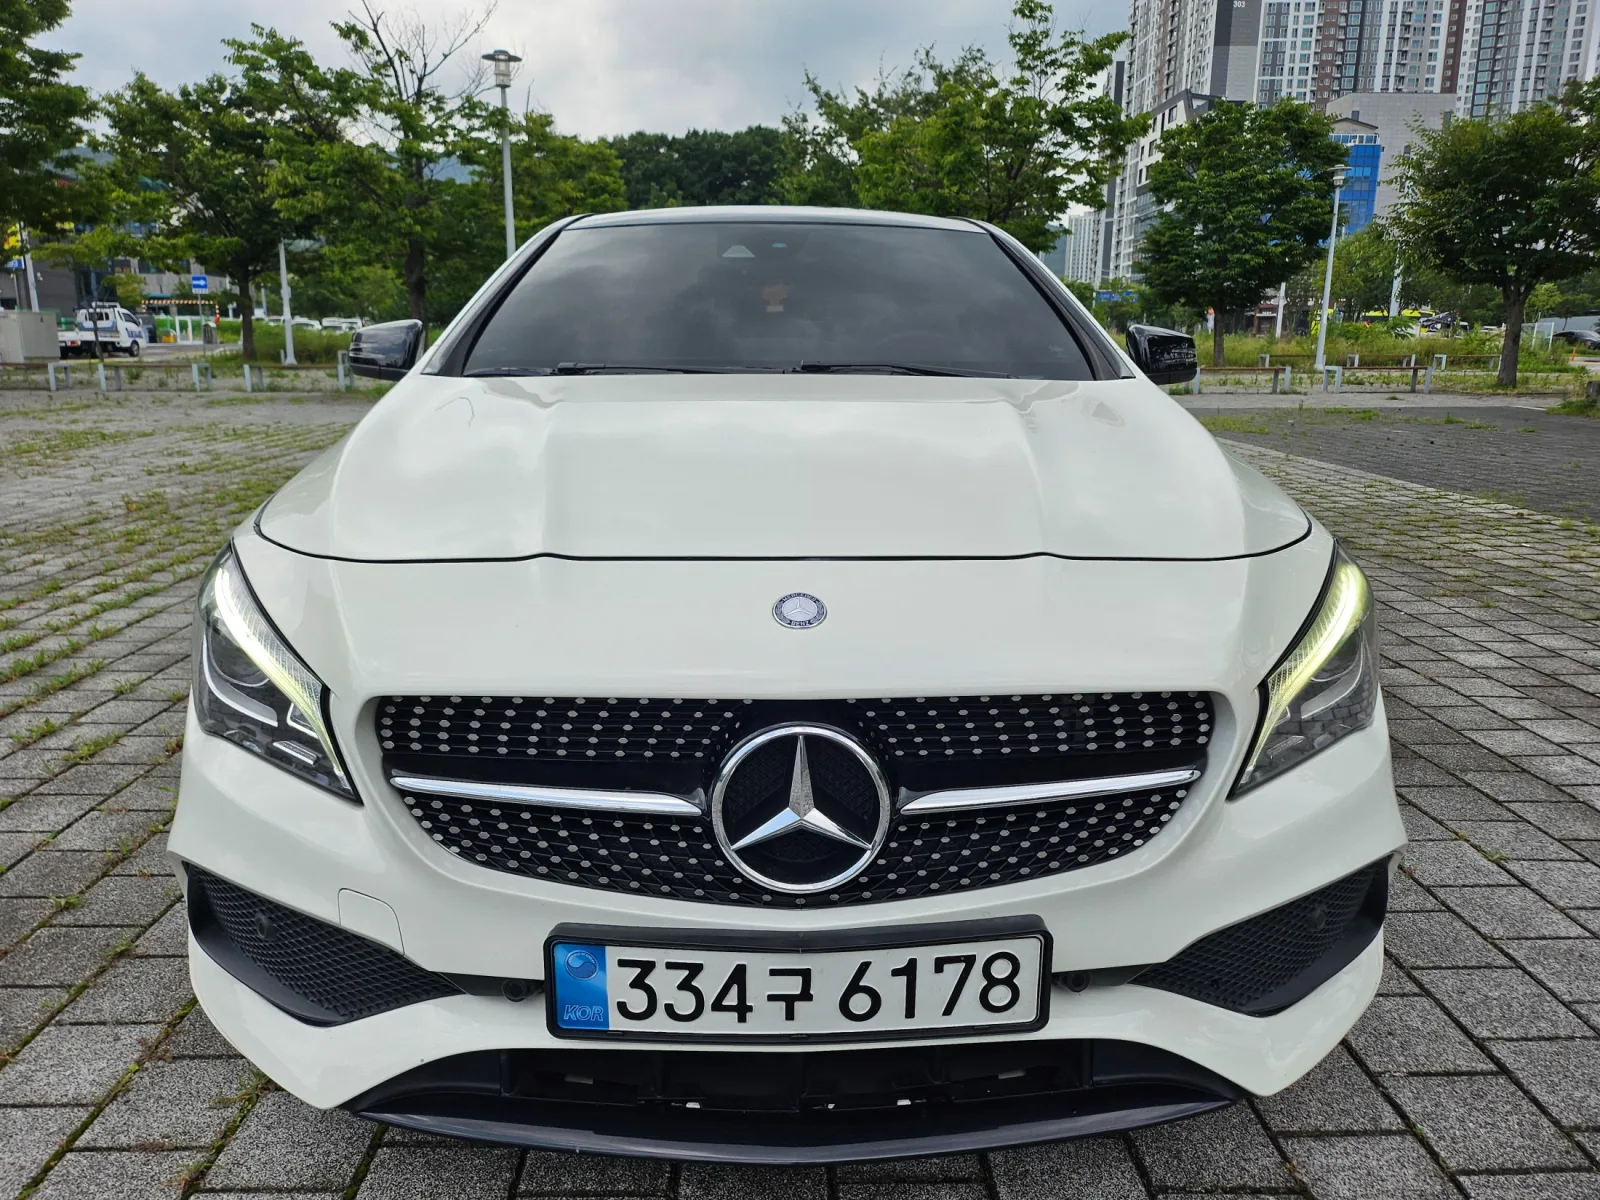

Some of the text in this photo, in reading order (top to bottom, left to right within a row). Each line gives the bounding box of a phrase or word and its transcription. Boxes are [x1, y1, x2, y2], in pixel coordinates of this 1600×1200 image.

[616, 951, 1021, 1024] 334구 6178
[564, 1005, 604, 1021] KOR
